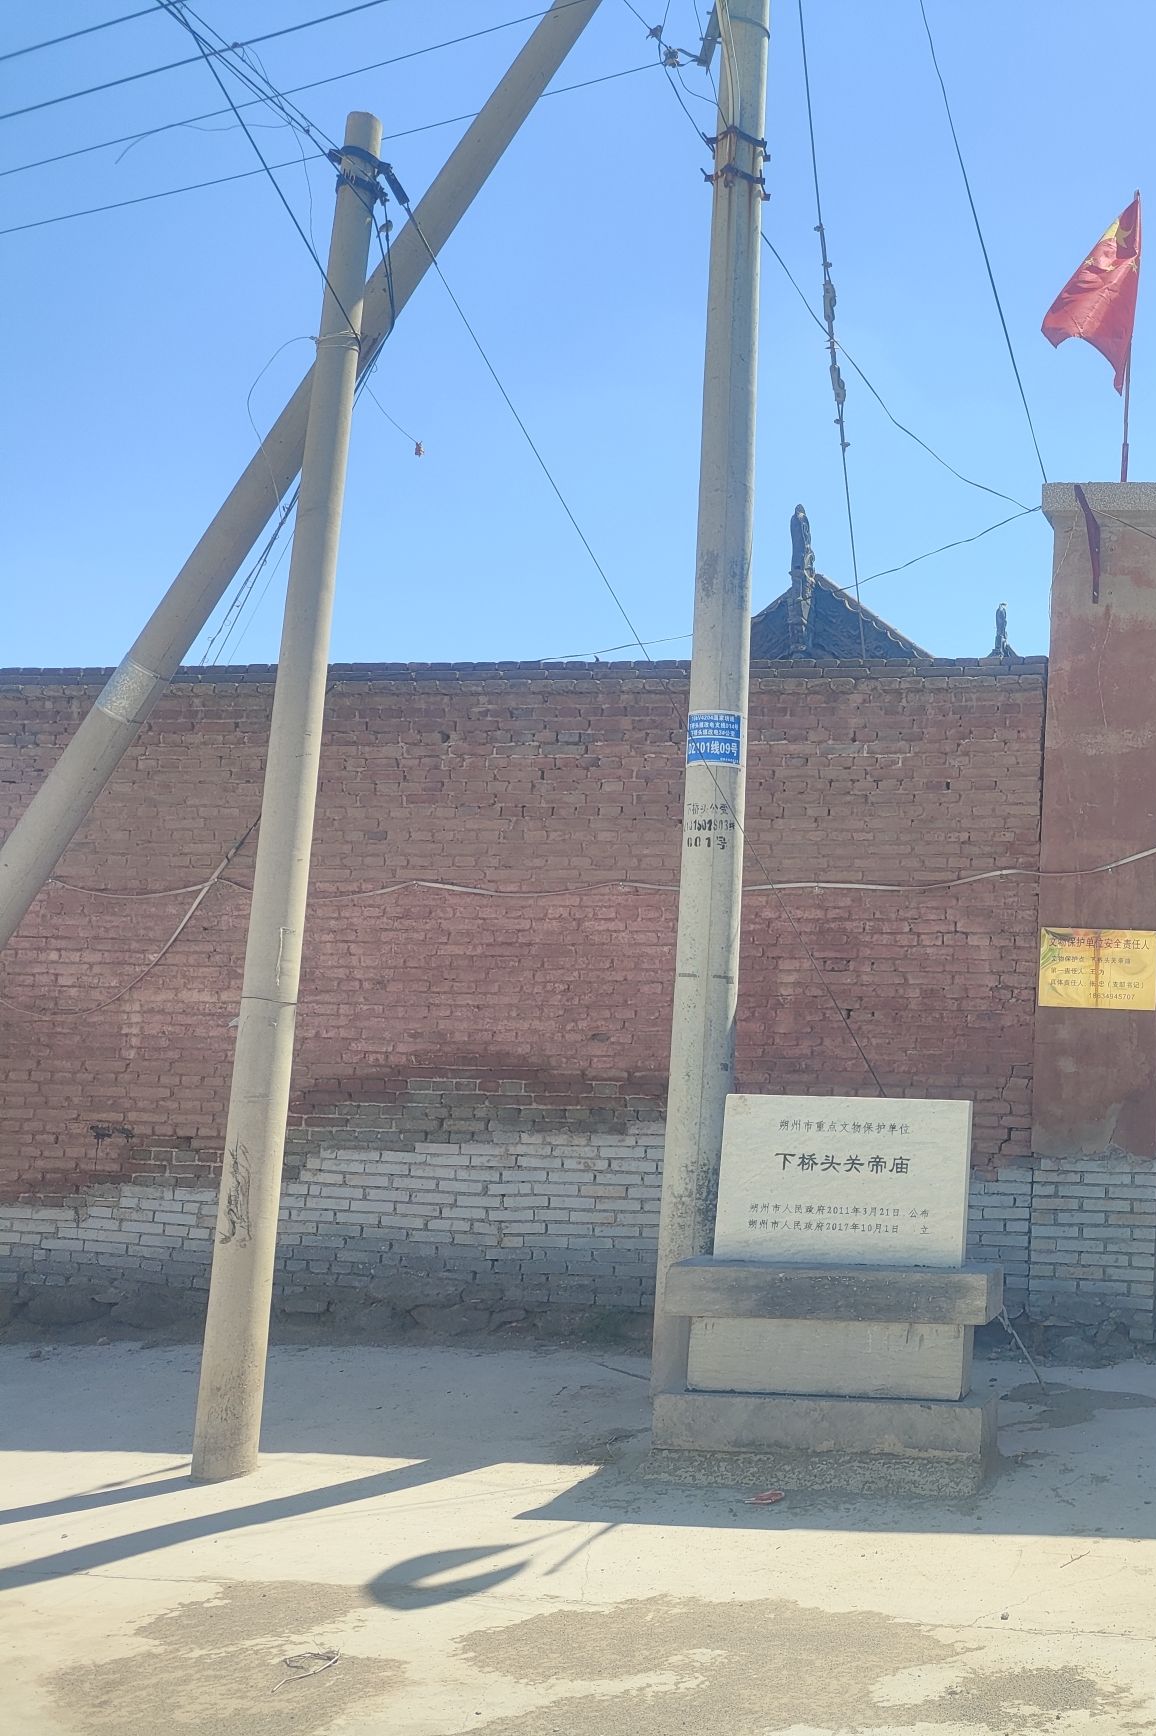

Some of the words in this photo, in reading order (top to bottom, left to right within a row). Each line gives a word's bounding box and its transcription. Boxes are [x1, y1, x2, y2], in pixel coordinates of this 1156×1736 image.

[1049, 937, 1150, 950] 文物保护单位安全责任人
[777, 1119, 911, 1136] 朔州市重点文物保护单位
[774, 1152, 911, 1175] 下桥头关帝庙
